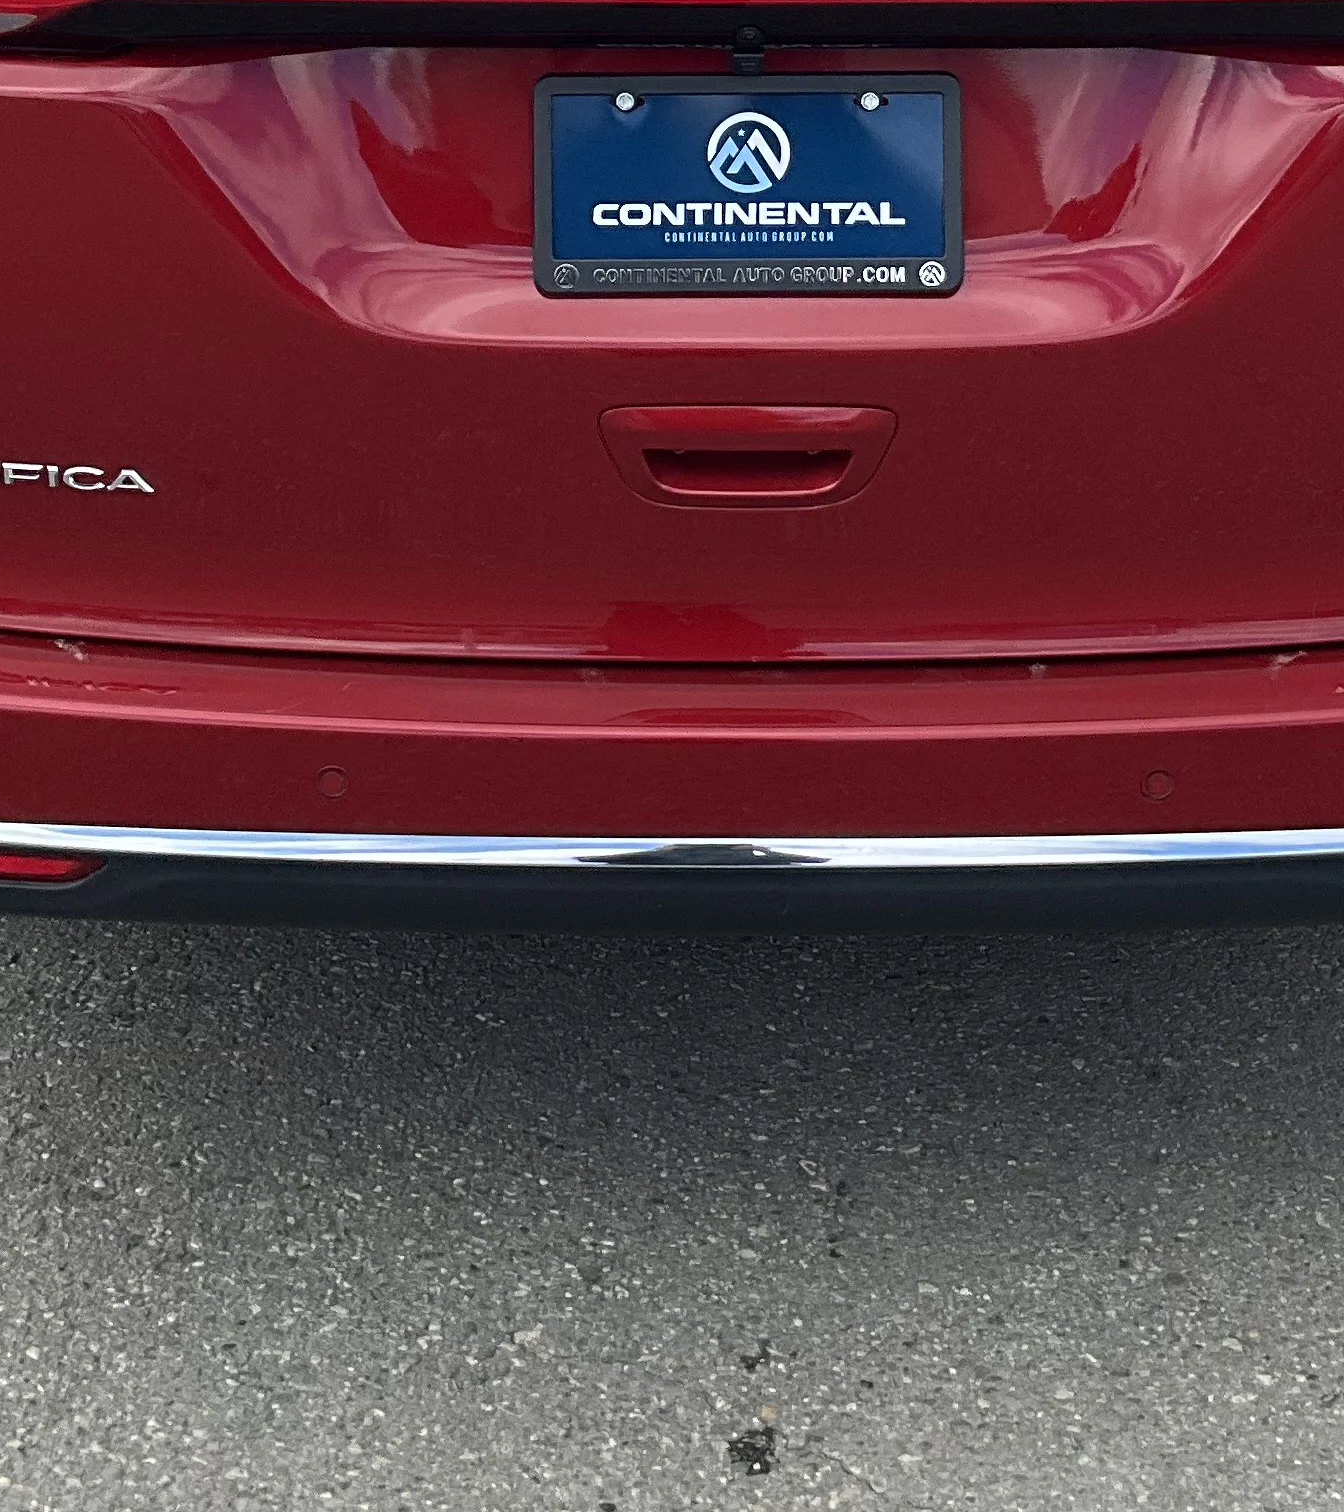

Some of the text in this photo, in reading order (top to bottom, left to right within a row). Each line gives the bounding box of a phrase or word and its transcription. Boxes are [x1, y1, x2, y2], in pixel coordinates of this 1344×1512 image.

[592, 201, 906, 226] CONTINENTAL
[593, 267, 727, 283] CONTINENTAL
[732, 267, 785, 283] AUTO
